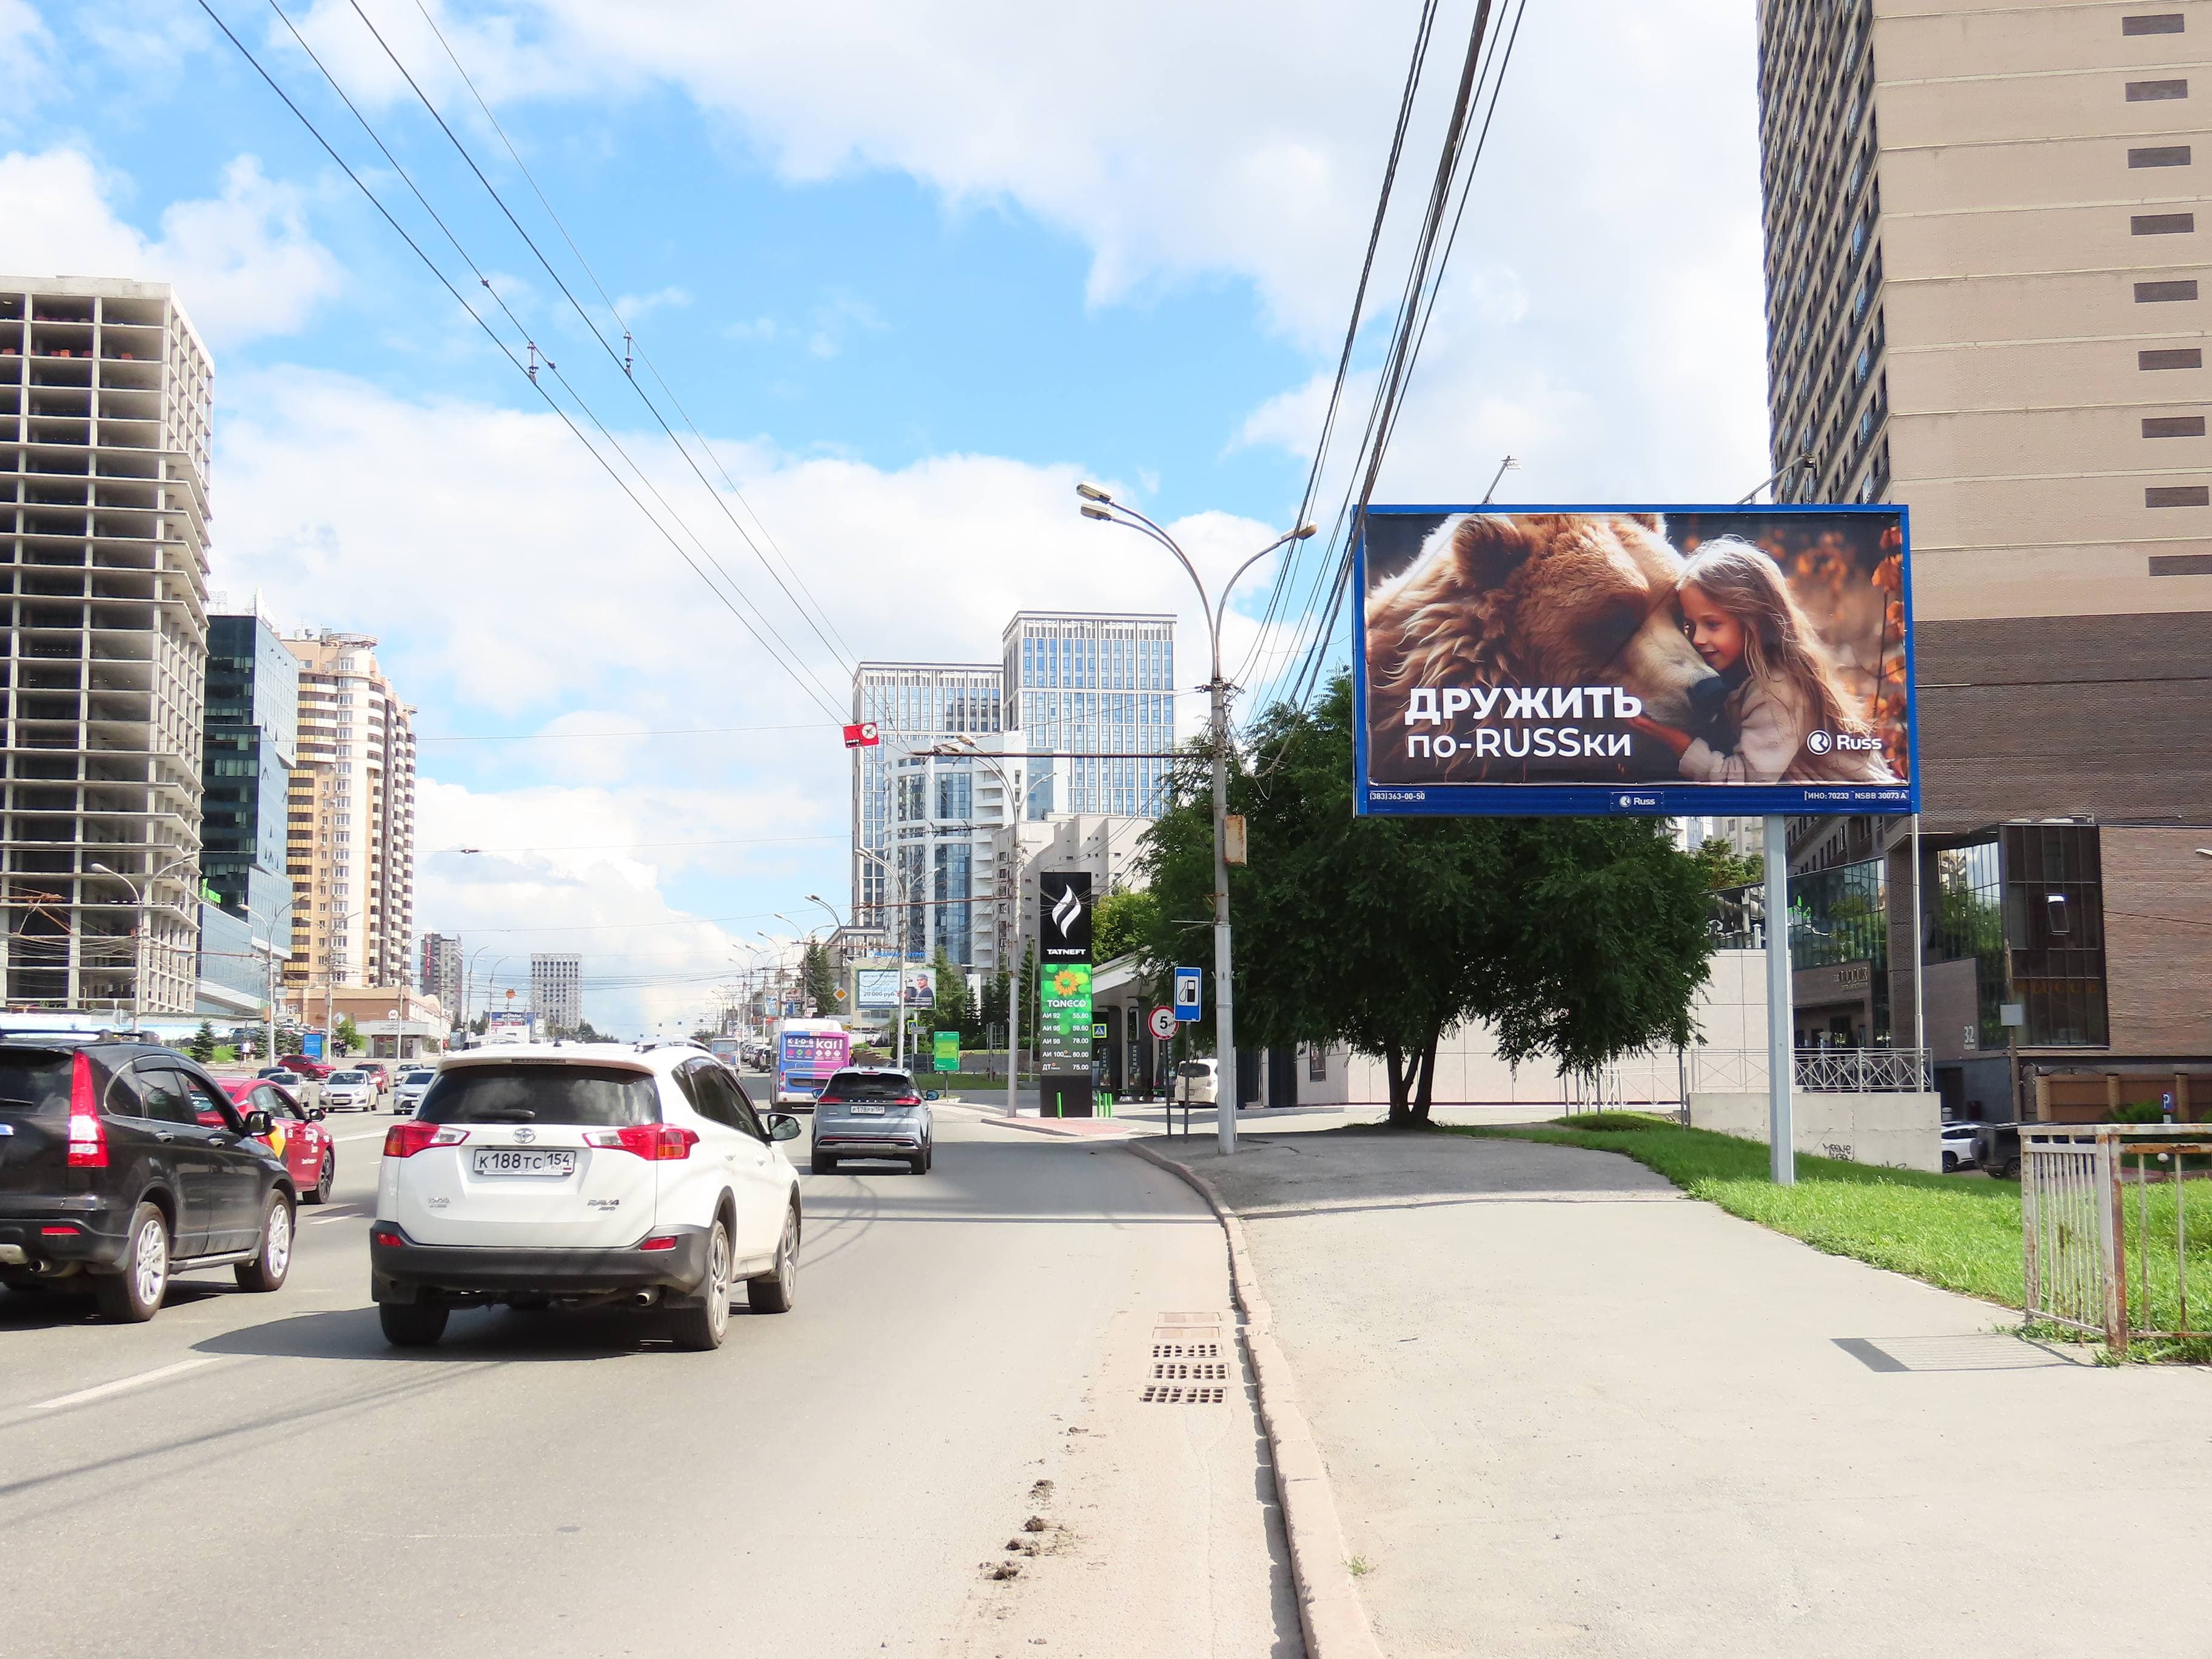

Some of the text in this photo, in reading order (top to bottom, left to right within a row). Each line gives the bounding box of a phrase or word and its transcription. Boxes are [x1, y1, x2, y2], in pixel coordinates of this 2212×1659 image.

[1404, 686, 1643, 726] ДРУЖИТЬ
[1407, 728, 1631, 758] по-RUSSки
[1836, 734, 1882, 750] Russ
[1634, 797, 1655, 805] Russ
[1159, 1016, 1168, 1030] 5
[1964, 1025, 1975, 1043] 32
[816, 1037, 843, 1049] kari
[547, 1153, 569, 1165] 154
